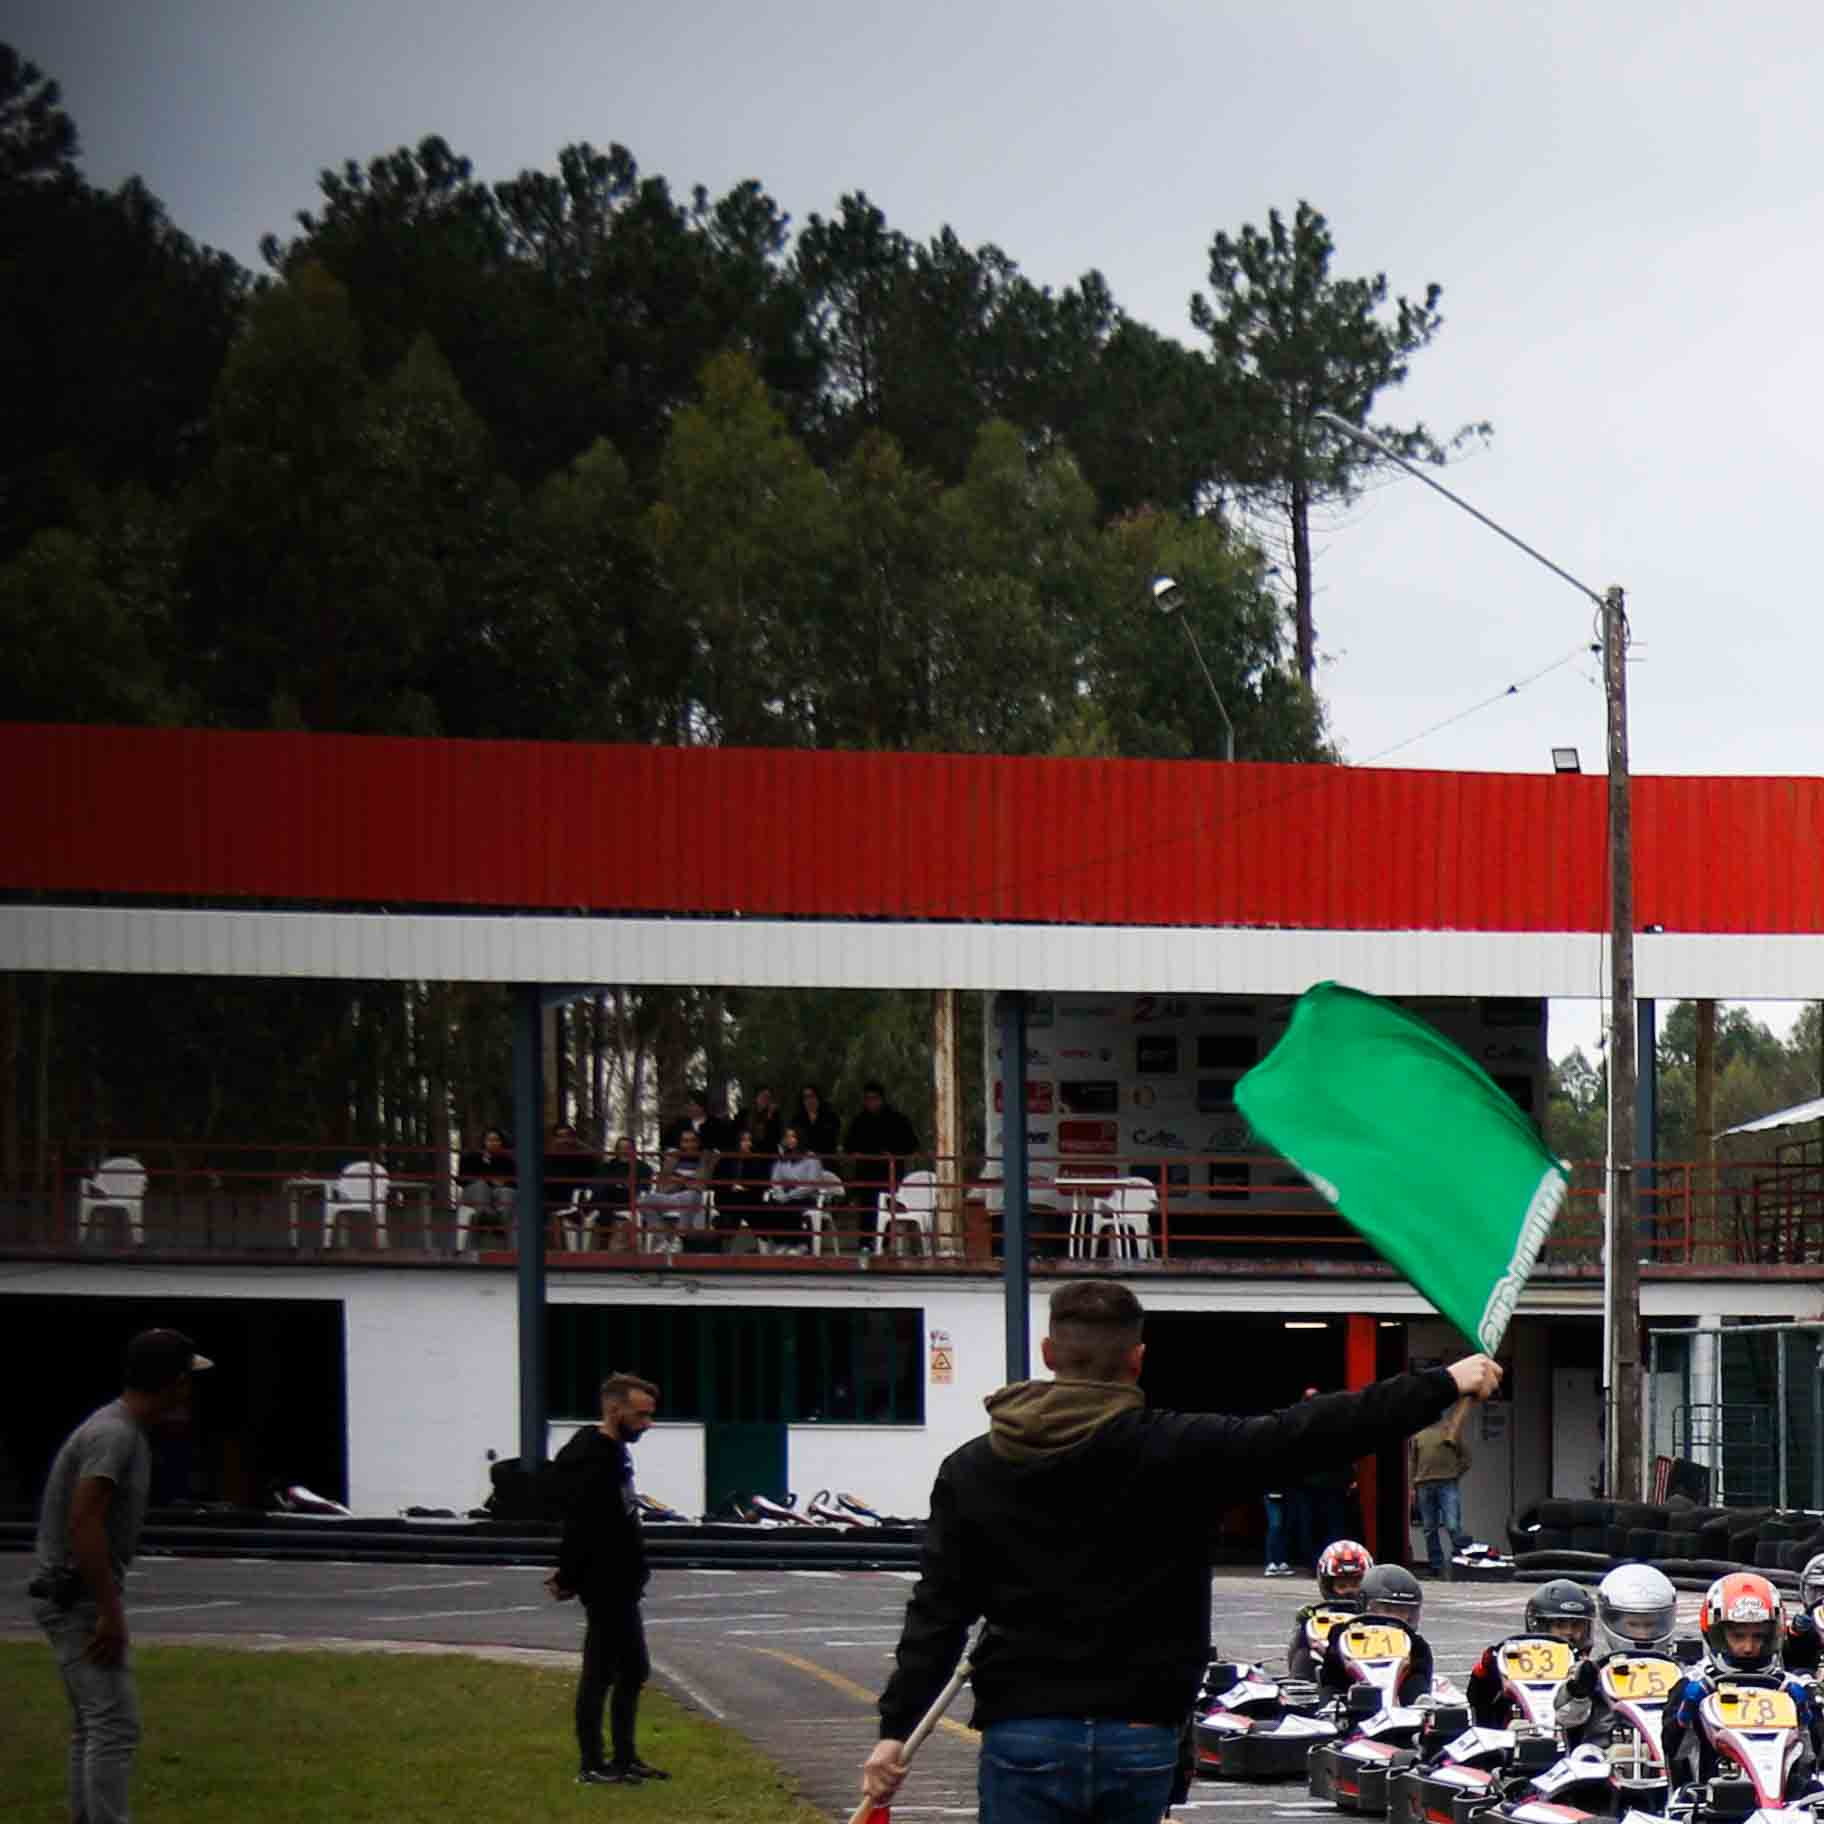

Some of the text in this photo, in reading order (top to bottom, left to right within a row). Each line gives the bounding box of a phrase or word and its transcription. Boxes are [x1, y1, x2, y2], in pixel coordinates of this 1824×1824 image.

[1362, 1634, 1393, 1654] 71
[1518, 1648, 1554, 1674] 63
[1627, 1667, 1666, 1696] 75
[1738, 1698, 1776, 1721] 78
